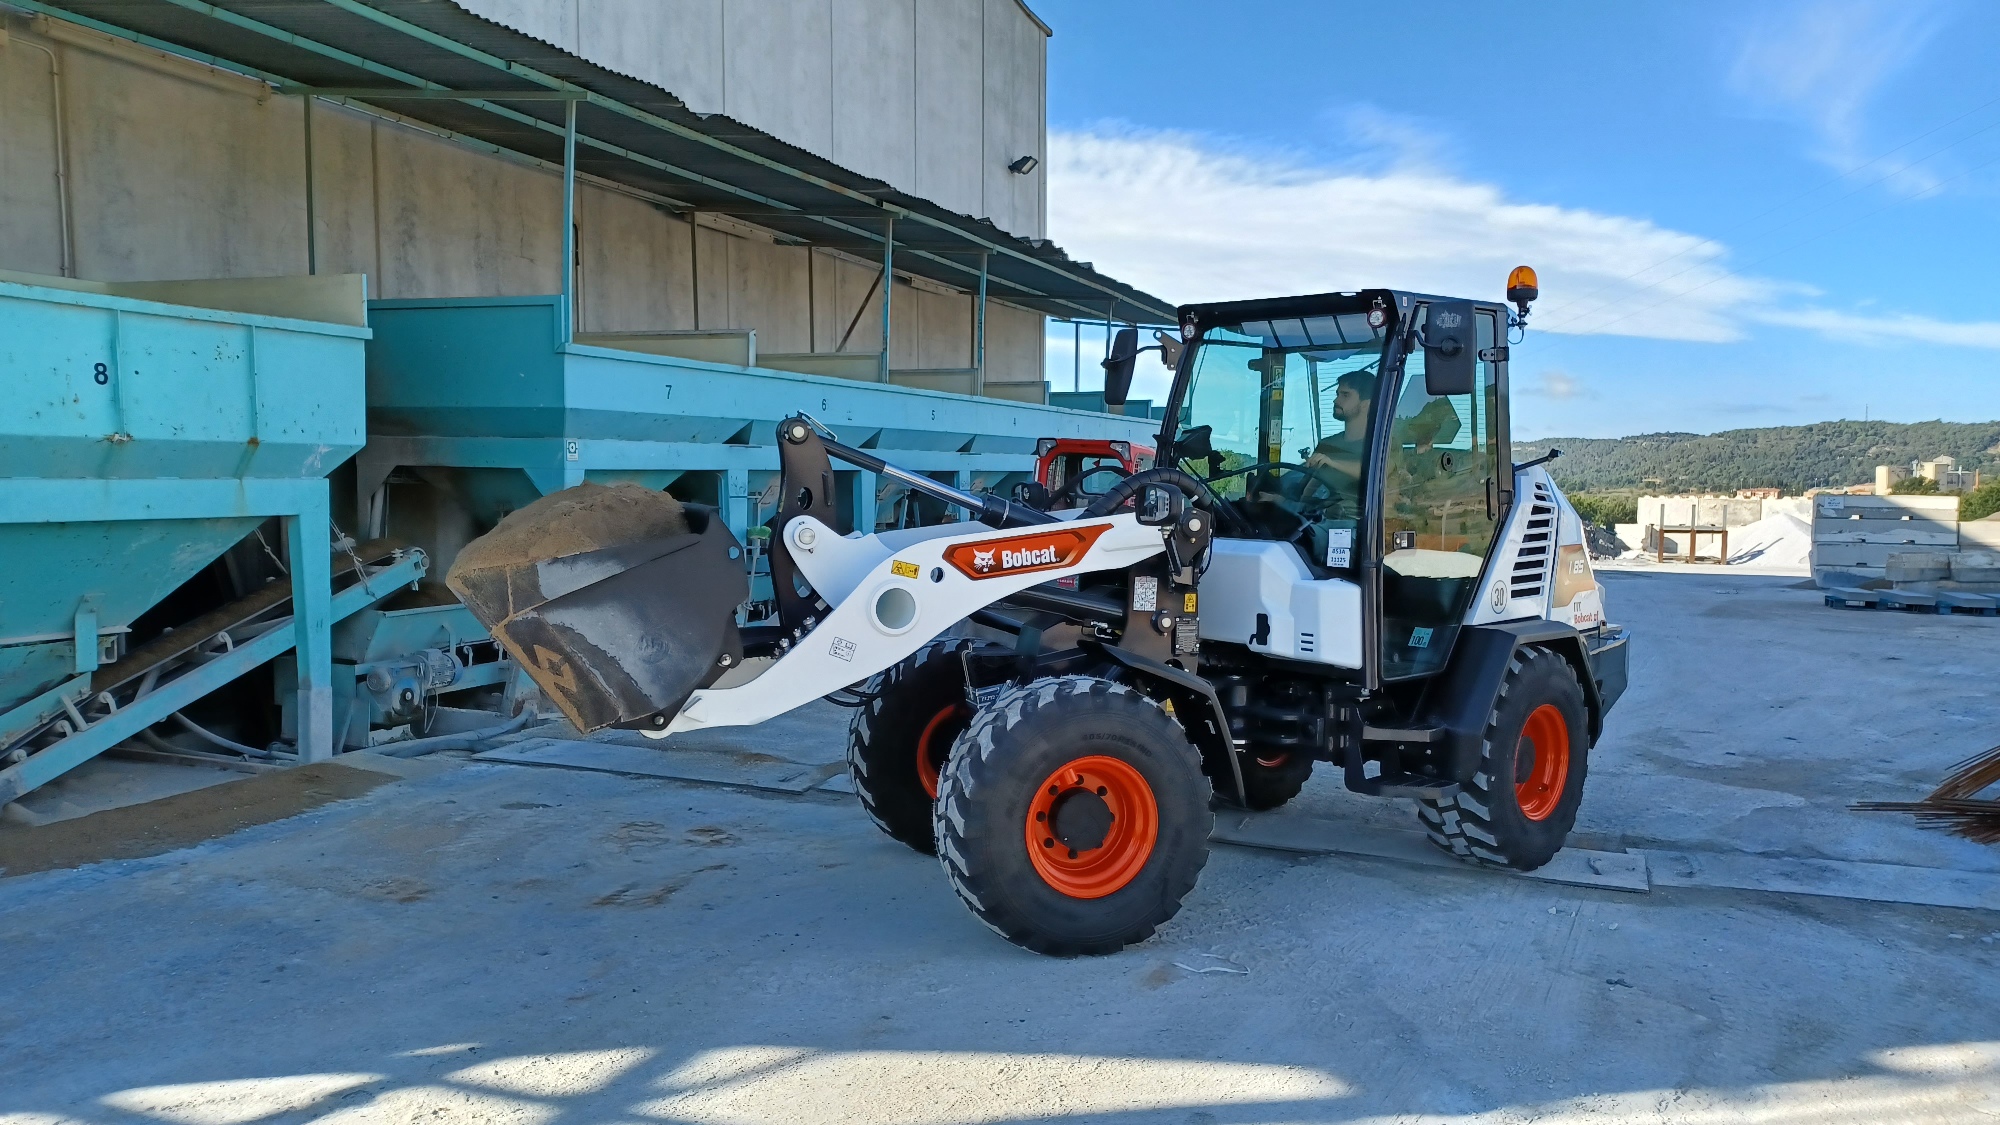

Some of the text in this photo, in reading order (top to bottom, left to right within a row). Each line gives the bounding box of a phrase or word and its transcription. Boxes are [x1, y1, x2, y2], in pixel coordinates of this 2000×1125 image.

[94, 362, 108, 385] 8
[665, 384, 672, 399] 7
[821, 399, 827, 411] 6
[1002, 545, 1057, 568] Bobcat
[1494, 588, 1504, 606] 30
